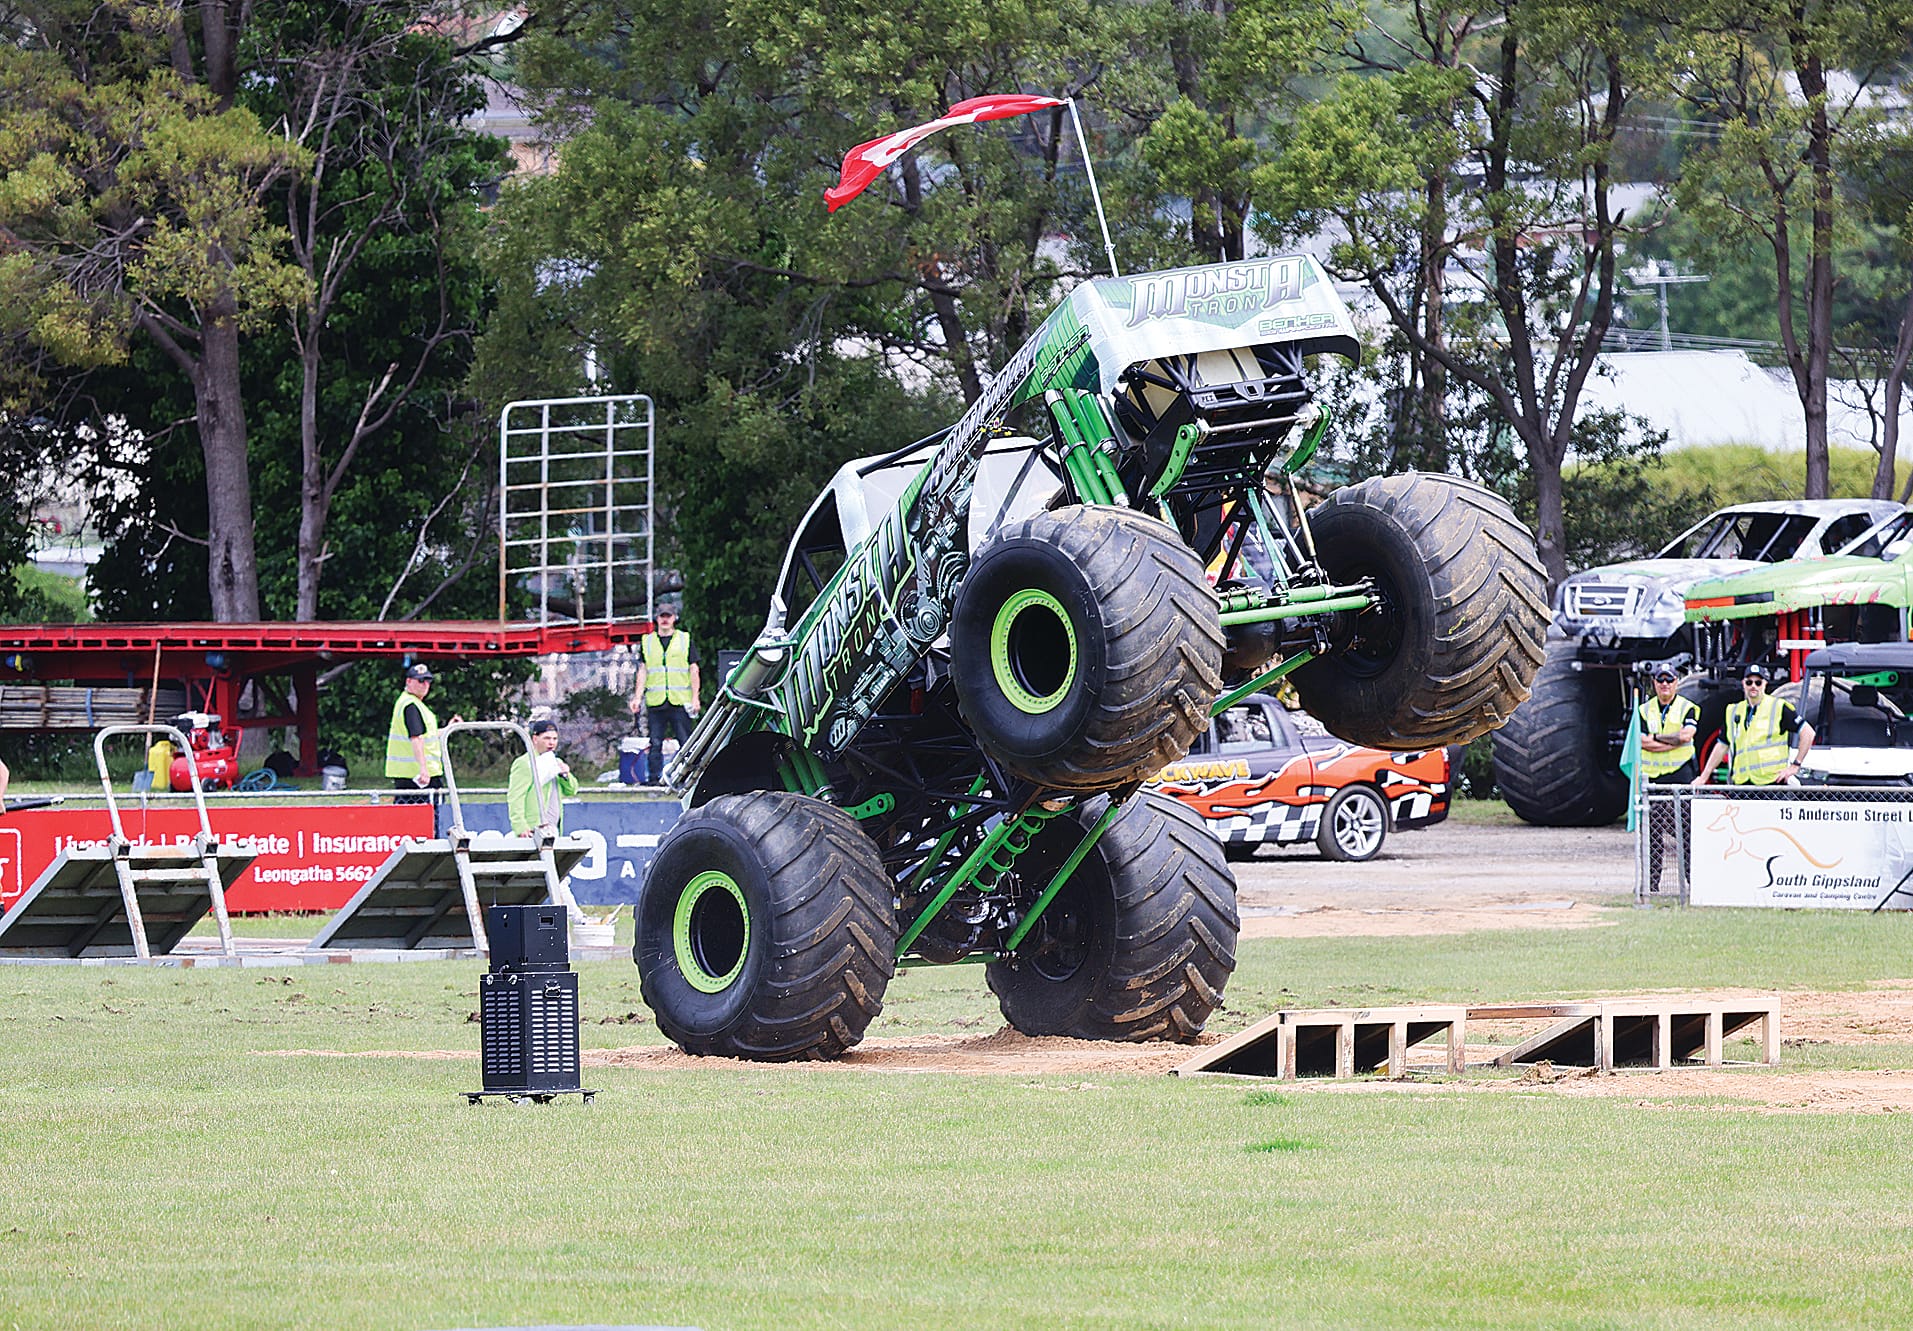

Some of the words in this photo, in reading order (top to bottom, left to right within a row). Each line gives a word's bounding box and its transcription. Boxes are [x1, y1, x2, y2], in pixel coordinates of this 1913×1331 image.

[1126, 257, 1304, 328] MONSTA
[1191, 295, 1257, 317] TRON
[781, 503, 912, 745] MONSTA
[830, 603, 877, 692] TRON
[1146, 760, 1251, 783] CKWAVE
[1780, 807, 1793, 821] 15
[1799, 807, 1858, 821] Anderson
[1864, 809, 1902, 822] Street
[254, 865, 333, 886] Leongatha
[1758, 855, 1808, 888] South
[1812, 874, 1881, 890] Gippsland
